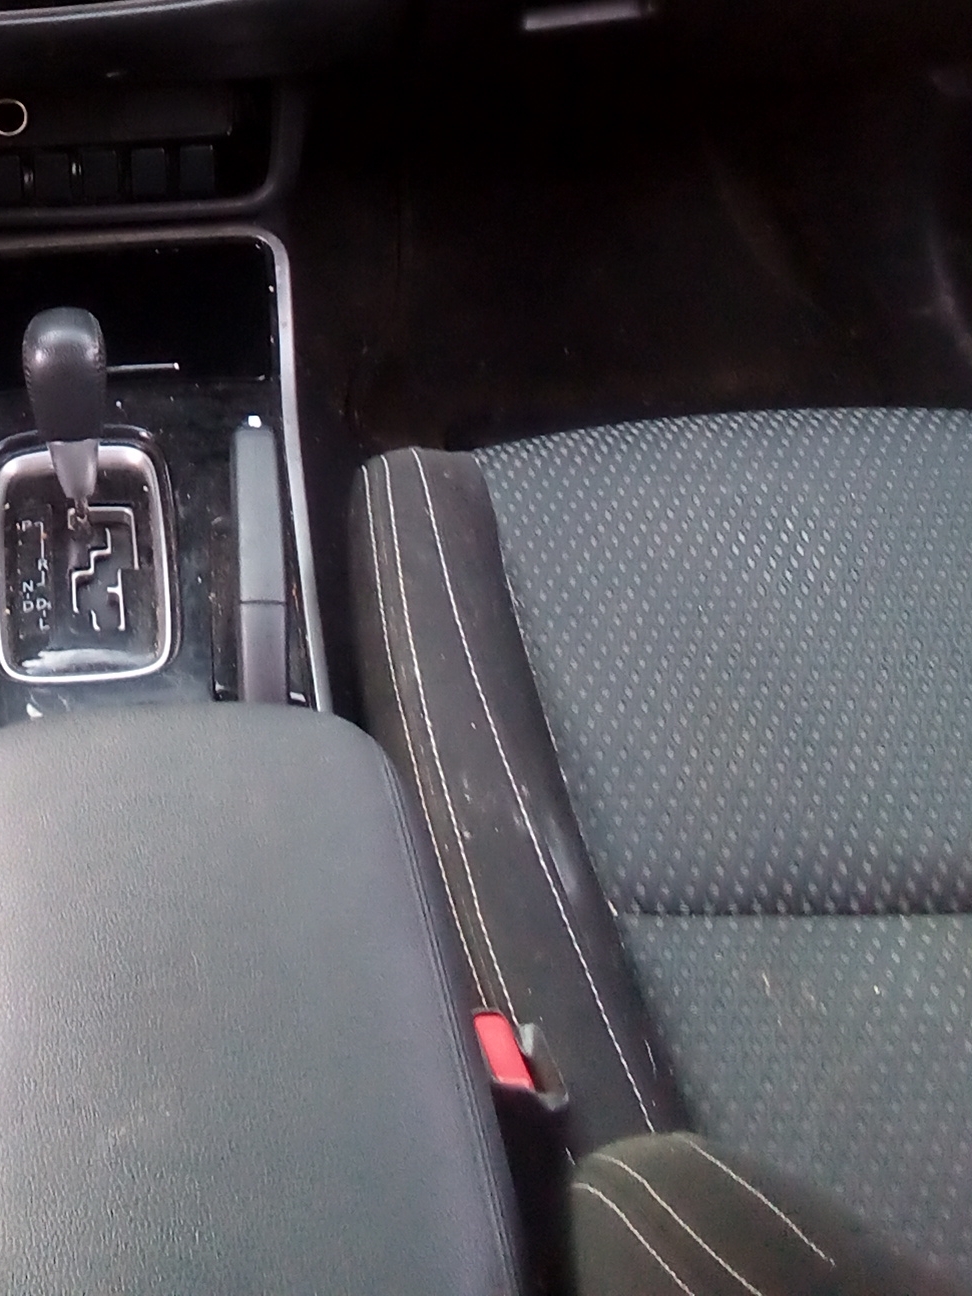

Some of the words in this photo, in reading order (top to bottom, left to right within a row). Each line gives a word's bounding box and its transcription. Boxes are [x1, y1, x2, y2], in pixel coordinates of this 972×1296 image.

[22, 519, 32, 532] P
[37, 558, 48, 572] R
[23, 580, 34, 593] N
[23, 600, 34, 614] D
[39, 617, 50, 630] L
